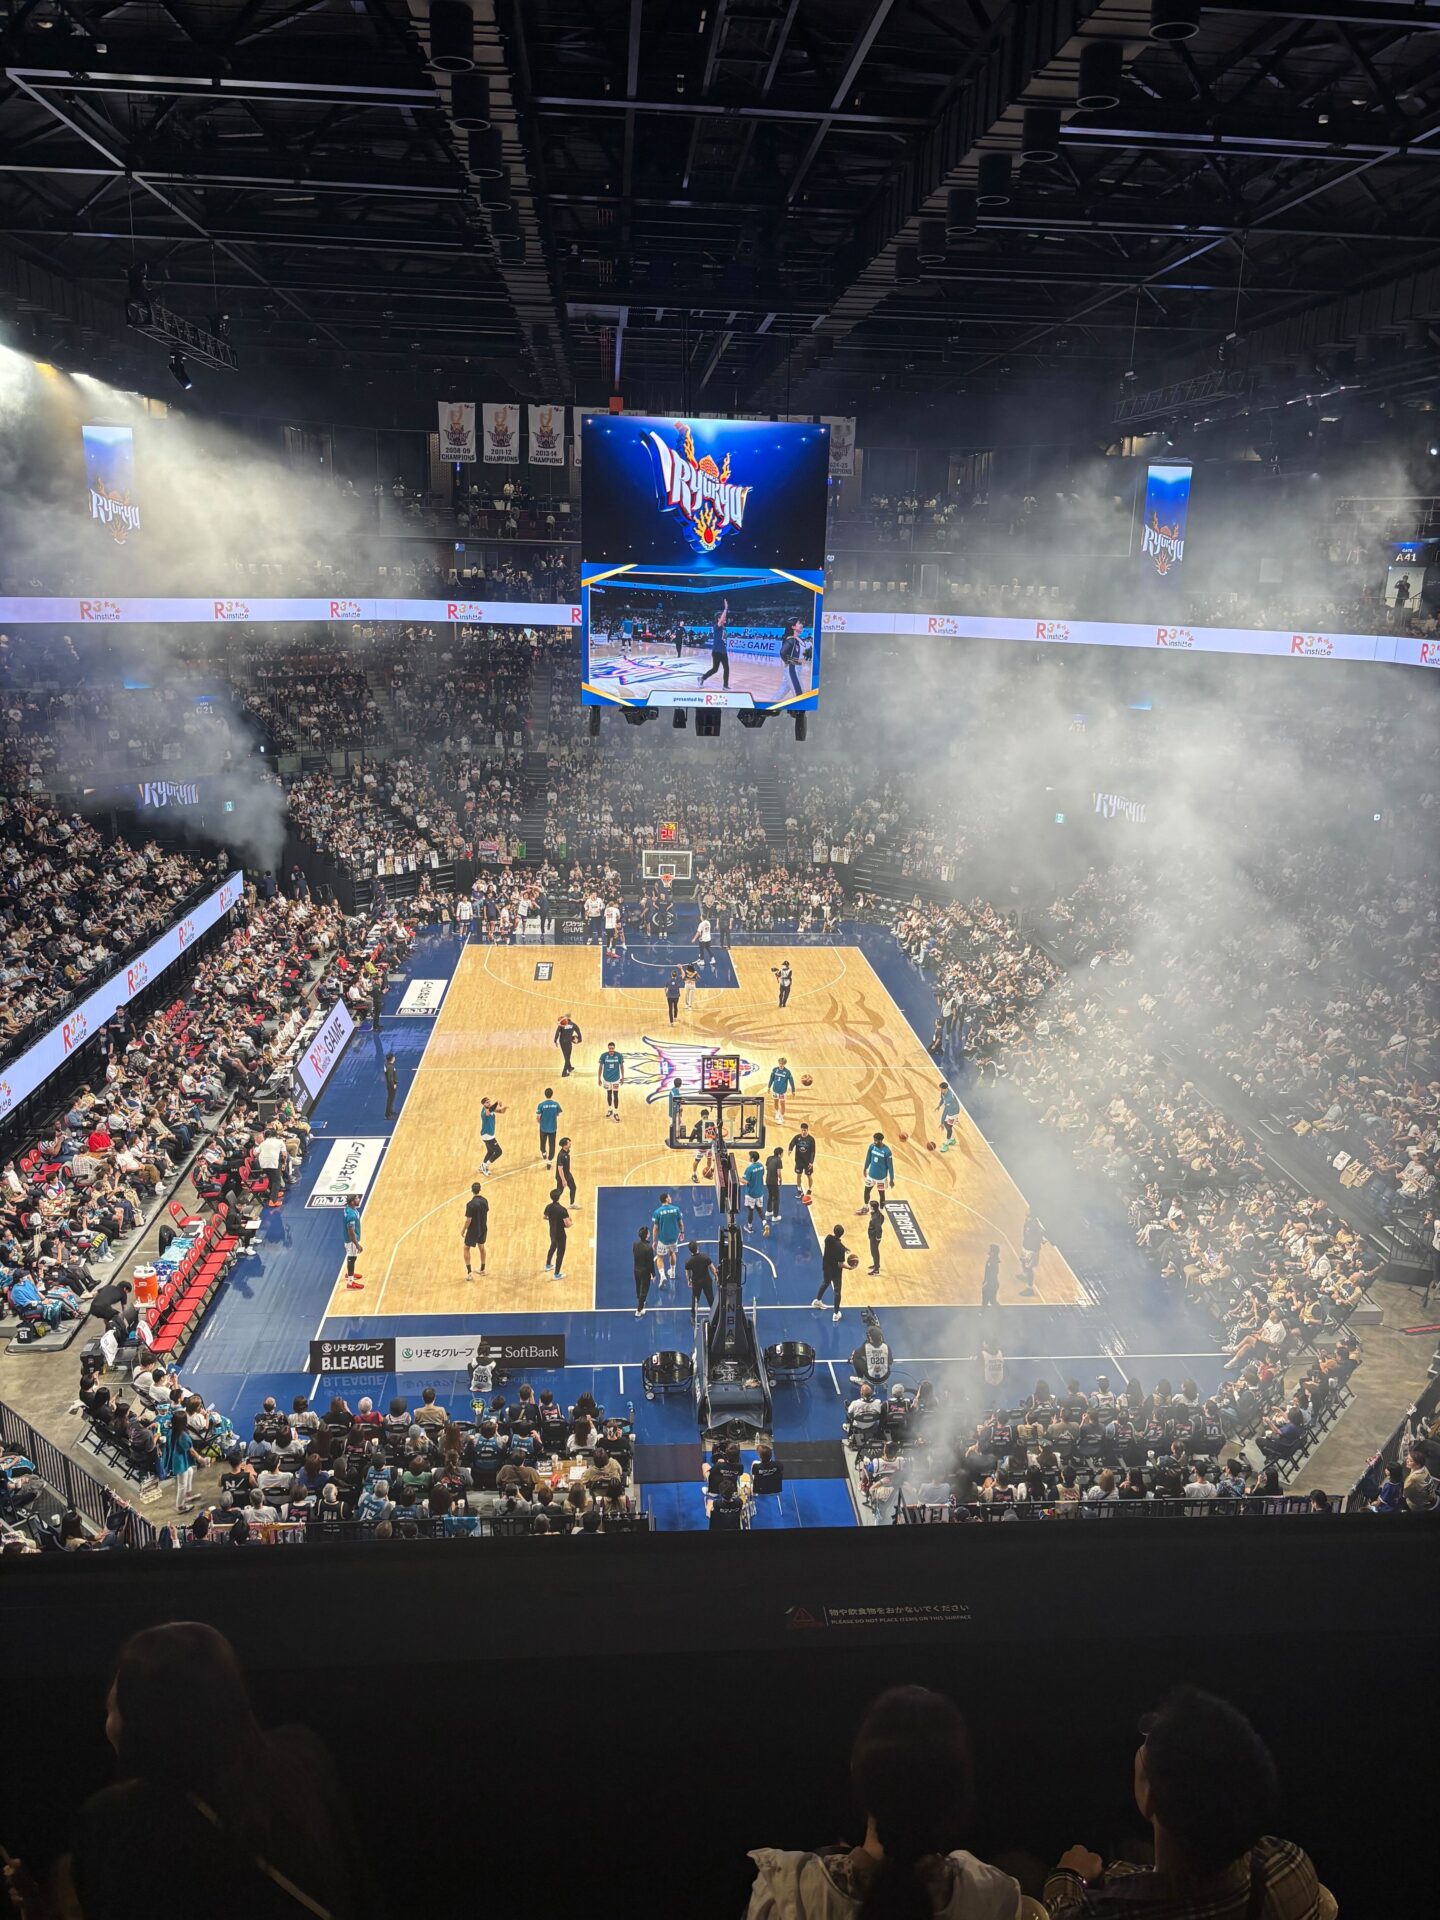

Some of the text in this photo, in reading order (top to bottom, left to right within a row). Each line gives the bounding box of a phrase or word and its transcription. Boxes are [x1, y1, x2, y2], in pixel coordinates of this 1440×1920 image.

[441, 453, 475, 461] CHAMPIONS
[484, 455, 518, 463] CHAMPIONS
[529, 456, 563, 465] CHAMPIONS
[1395, 553, 1417, 562] A41
[747, 641, 776, 651] GAME
[661, 829, 674, 840] 24
[324, 1016, 346, 1054] GAME
[336, 1141, 366, 1181] りそなグループ
[893, 1212, 923, 1246] B.LEAGUE
[333, 1342, 385, 1352] りそなグループ
[505, 1345, 559, 1358] SoftBank
[415, 1347, 475, 1359] りそなグループ
[321, 1355, 385, 1371] B.LEAGUE
[870, 1356, 885, 1365] 020
